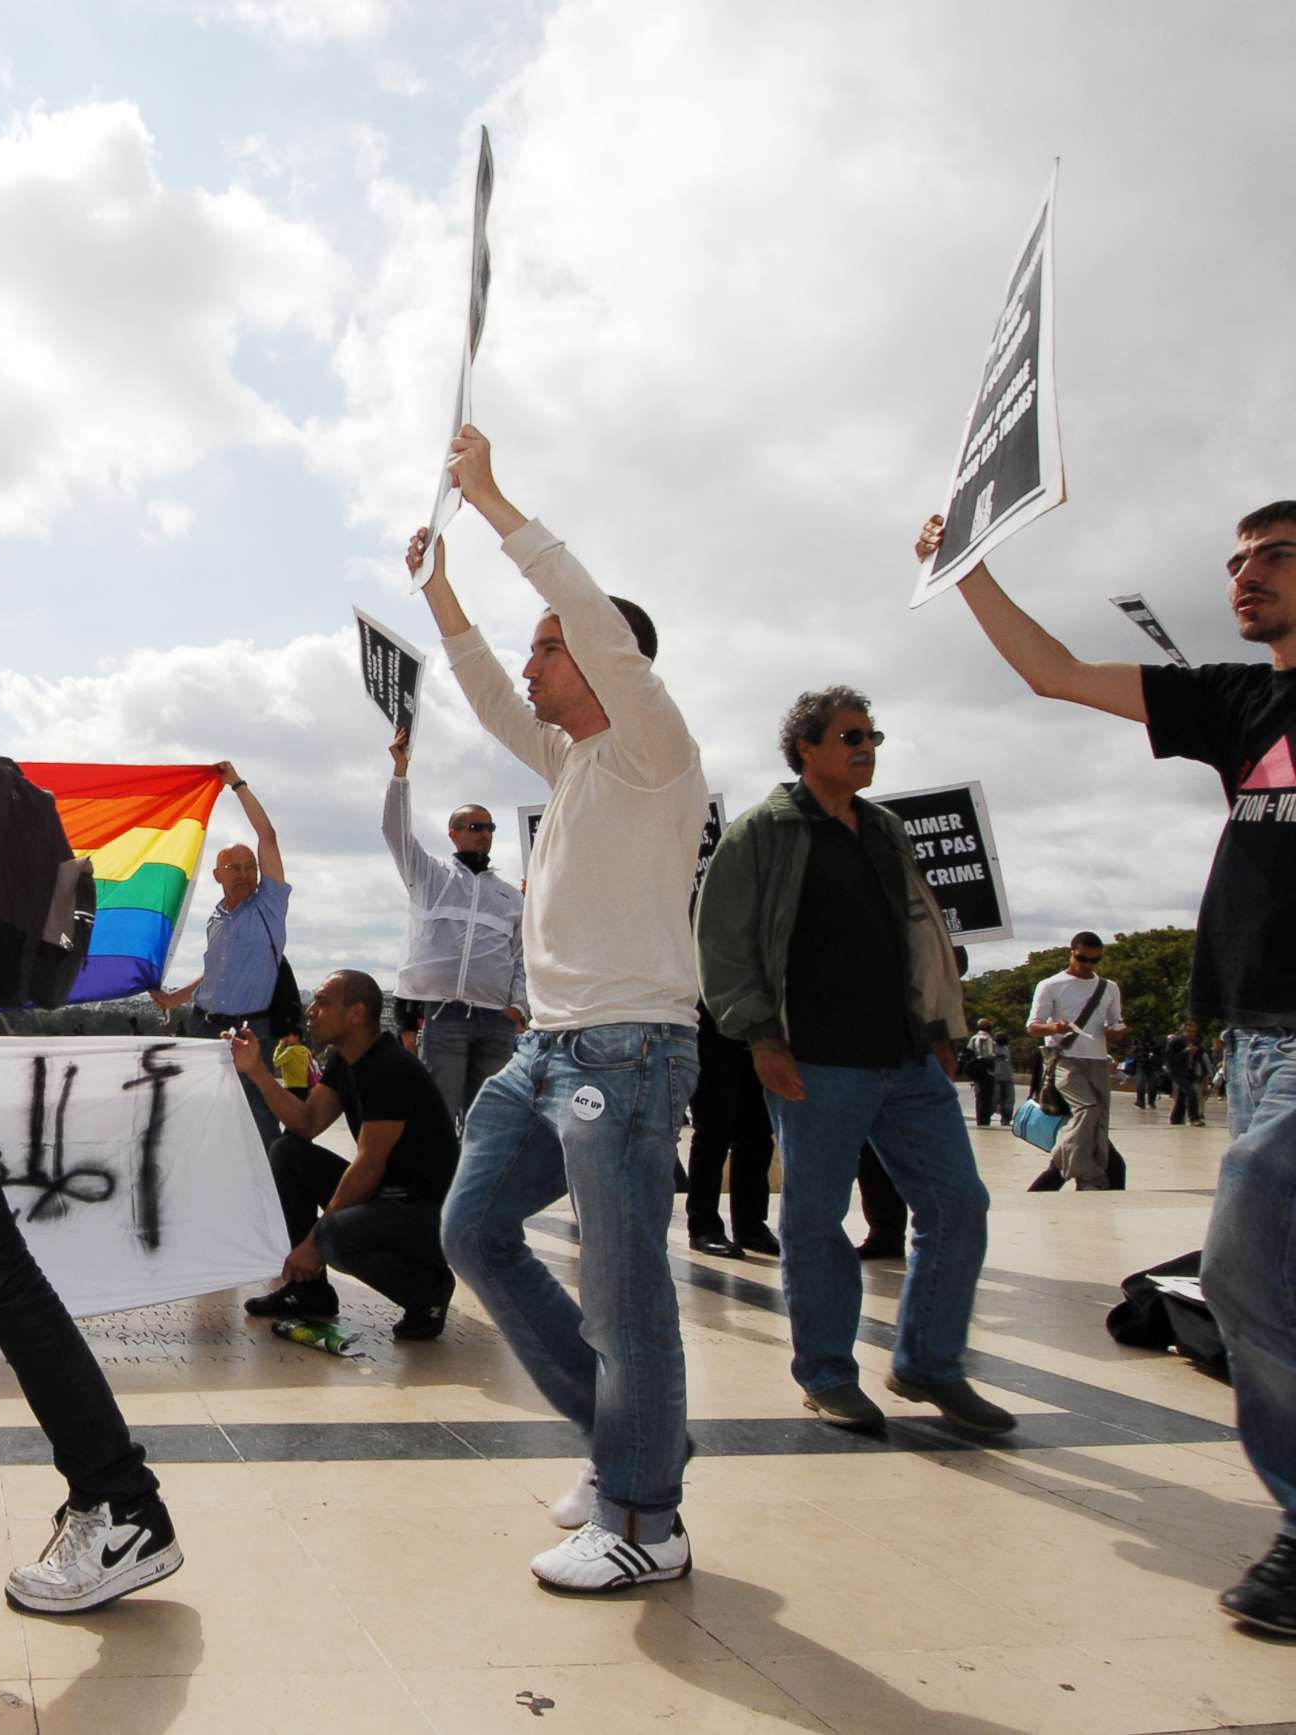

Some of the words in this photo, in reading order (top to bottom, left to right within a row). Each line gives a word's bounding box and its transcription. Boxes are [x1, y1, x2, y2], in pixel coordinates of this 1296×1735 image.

[904, 813, 964, 837] AIMER
[913, 841, 936, 860] ST
[940, 834, 977, 855] PAS
[926, 863, 986, 886] CRIME
[574, 1096, 589, 1106] ACT
[590, 1100, 602, 1110] UP
